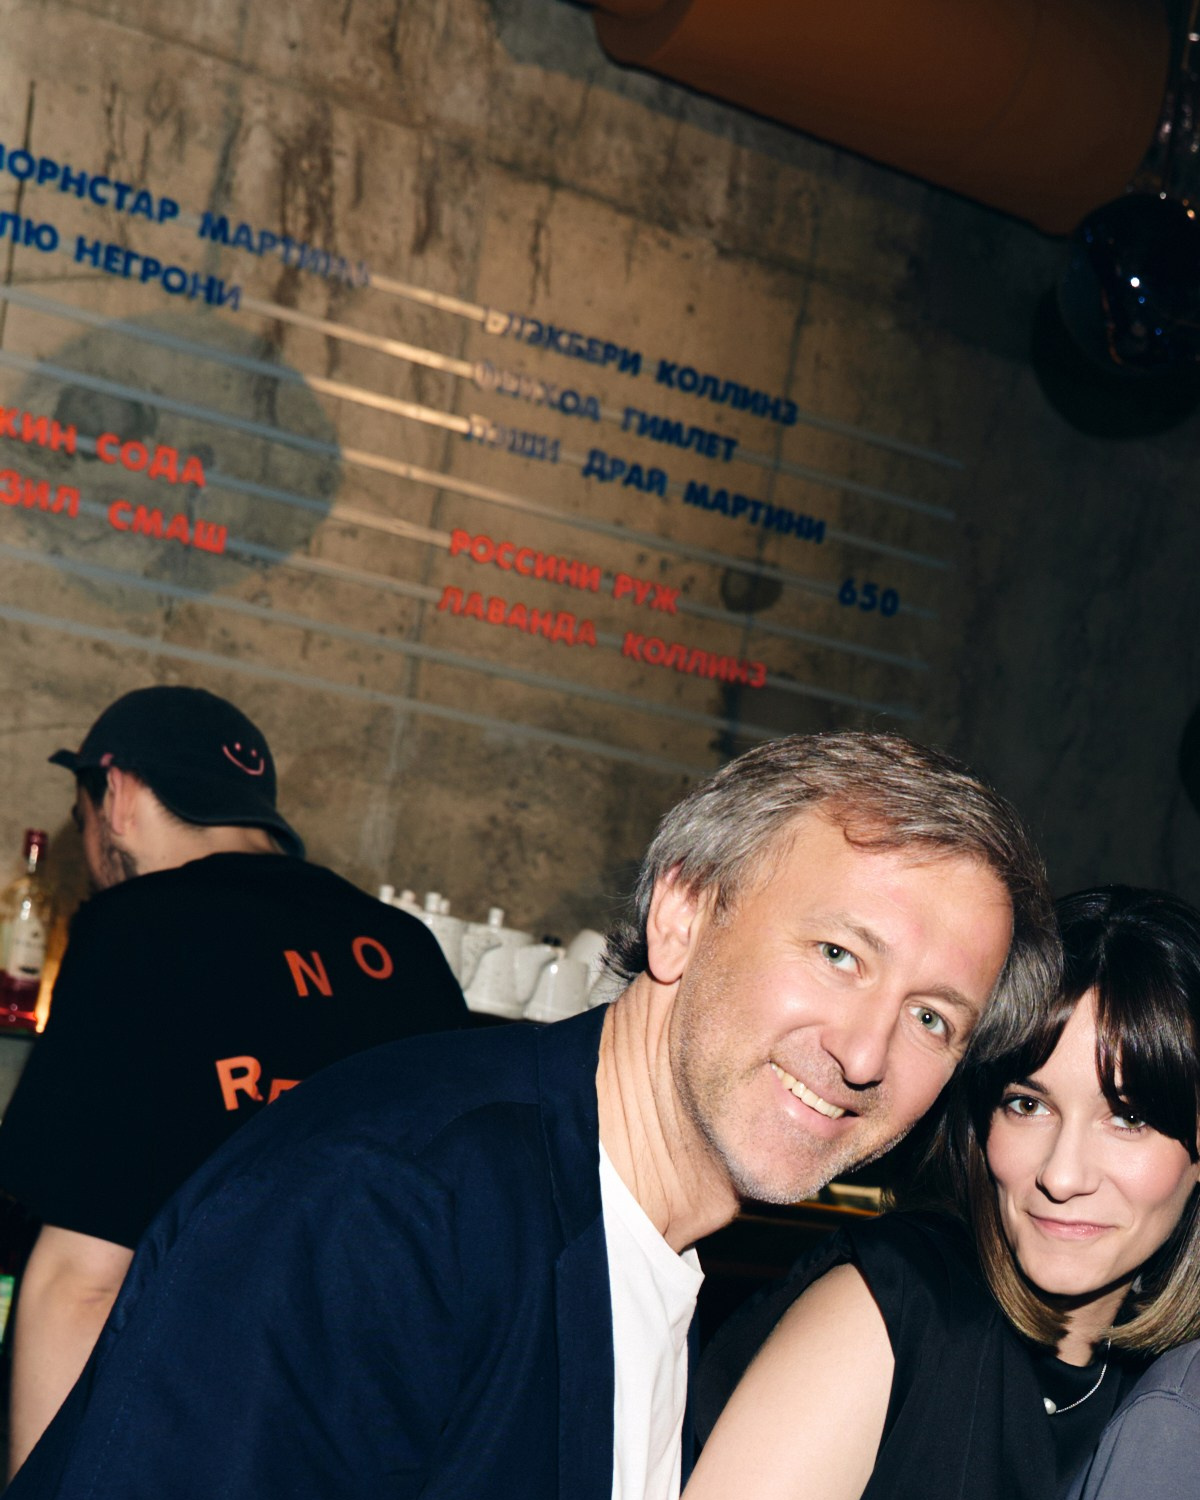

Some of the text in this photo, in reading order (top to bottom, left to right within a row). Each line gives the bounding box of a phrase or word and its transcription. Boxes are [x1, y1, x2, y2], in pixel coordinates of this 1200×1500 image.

[74, 235, 242, 311] НЕГРОНИ
[656, 358, 799, 426] КОЛЛИНЗ
[96, 431, 206, 488] СОДА
[621, 406, 739, 463] ГИМЛЕТ
[107, 499, 227, 554] СМАШ
[683, 481, 827, 544] МАРТИНИ
[450, 528, 681, 615] РОССИНИ РУЖ
[838, 578, 900, 618] 650
[437, 585, 768, 688] ЛАВАНДА КОЛЛИНЗ
[283, 936, 394, 997] NO
